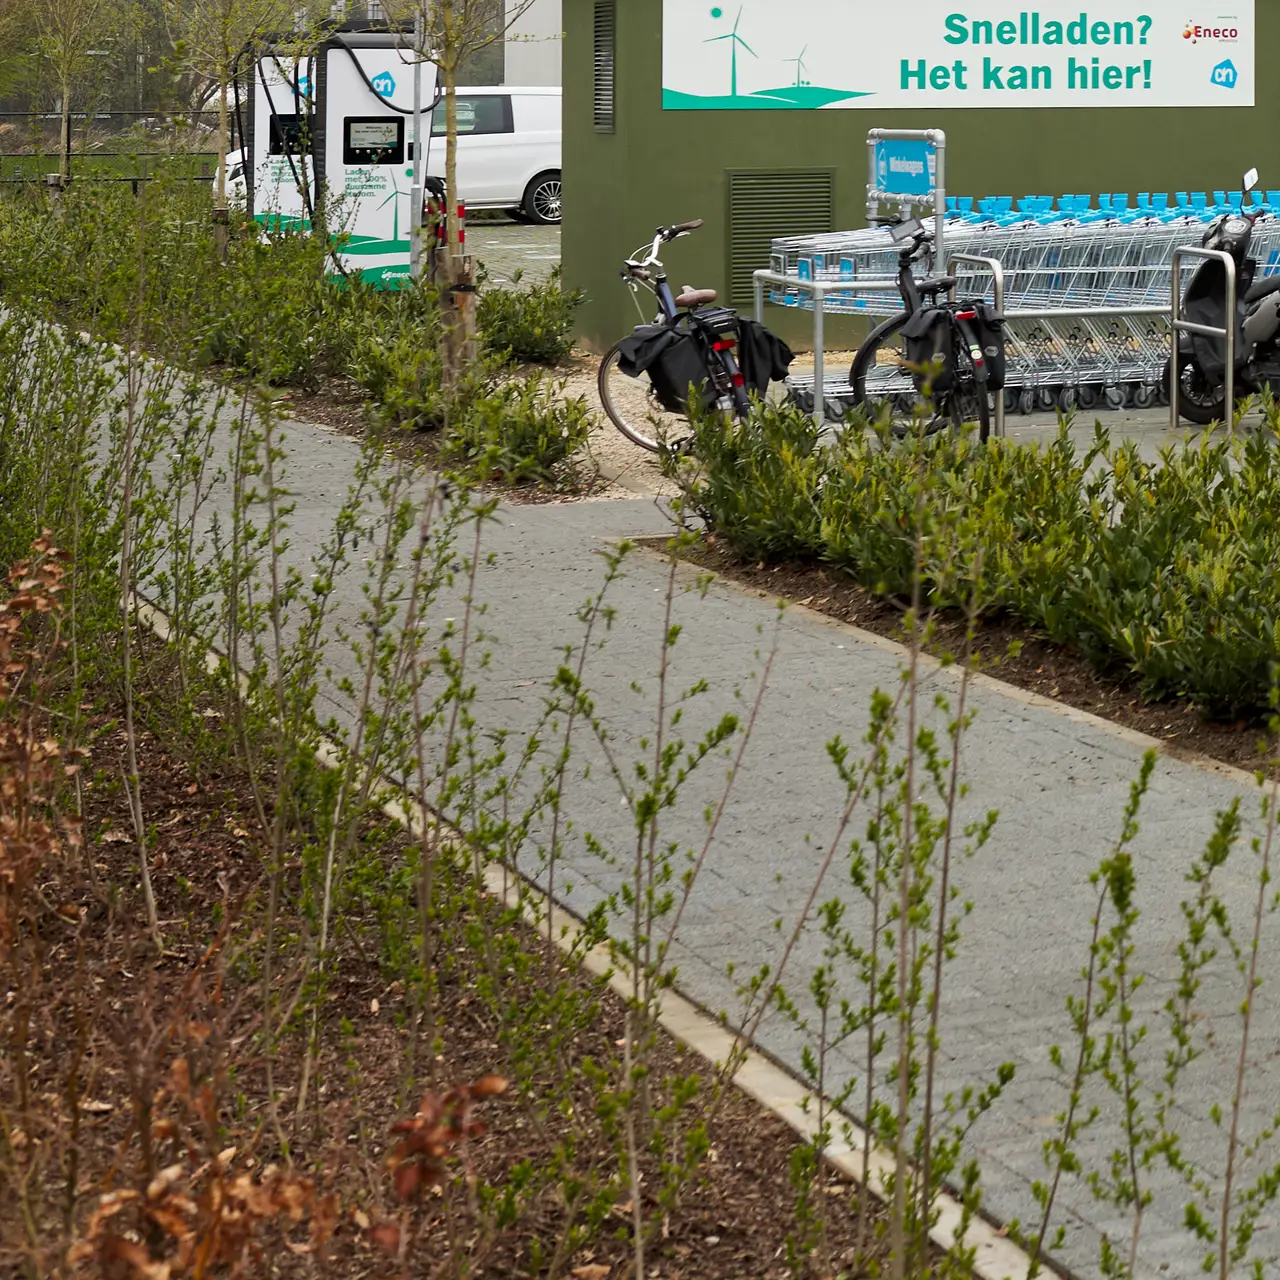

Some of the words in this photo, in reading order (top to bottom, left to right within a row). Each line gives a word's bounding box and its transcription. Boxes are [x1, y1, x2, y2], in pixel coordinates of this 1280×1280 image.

[943, 12, 1153, 46] Snelladen?
[1193, 25, 1238, 38] Eneco
[900, 59, 968, 90] Het
[982, 56, 1052, 90] kan
[1067, 56, 1153, 90] hier!
